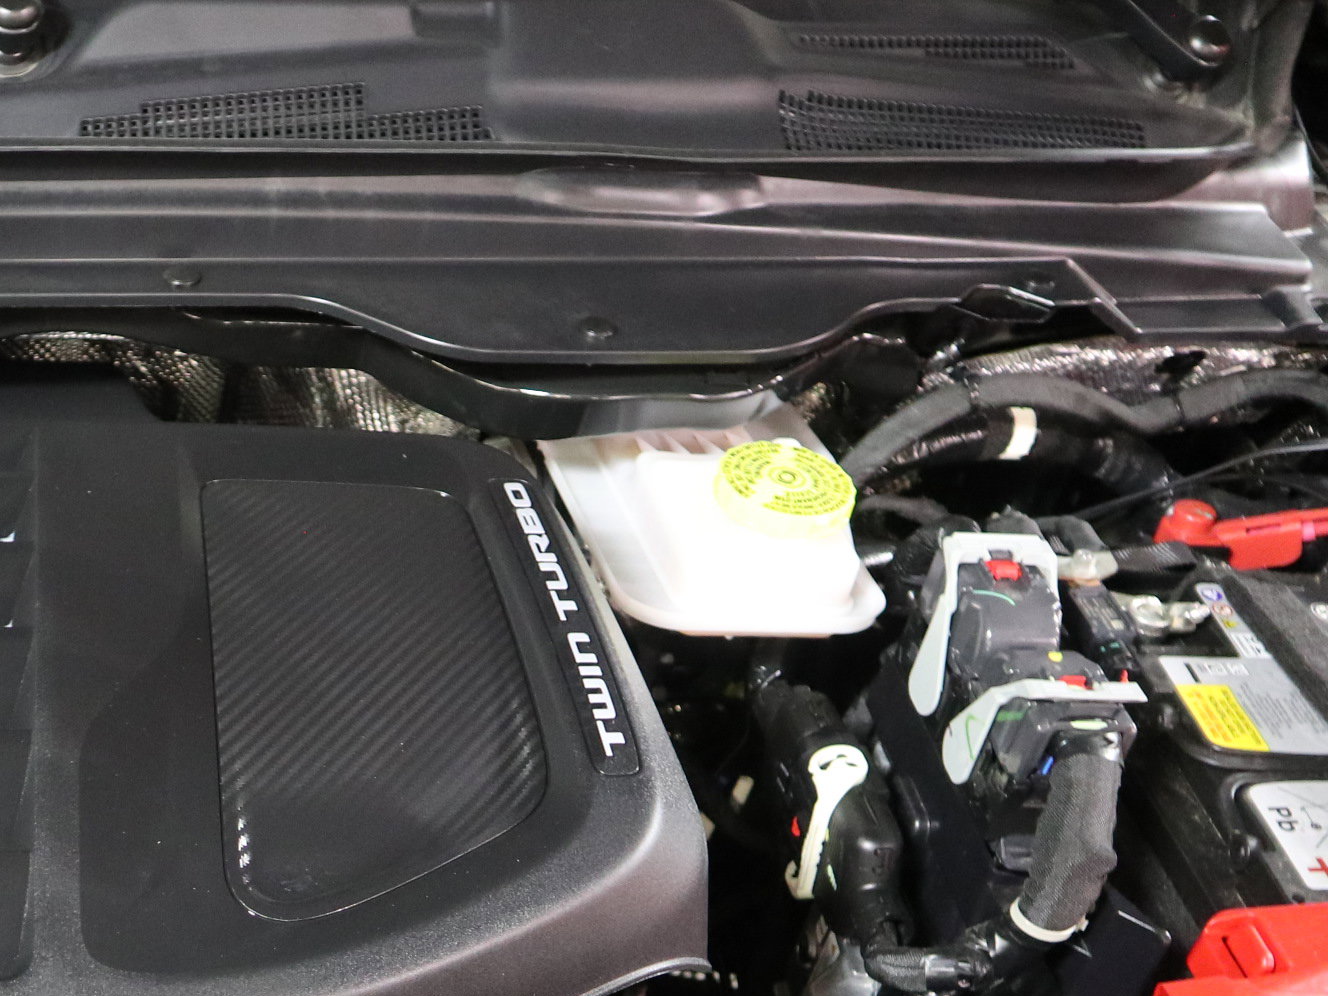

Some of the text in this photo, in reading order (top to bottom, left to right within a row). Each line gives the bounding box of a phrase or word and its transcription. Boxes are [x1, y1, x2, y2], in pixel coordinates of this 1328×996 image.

[503, 481, 626, 757] TWIN TURBO
[1268, 807, 1299, 832] Pb
